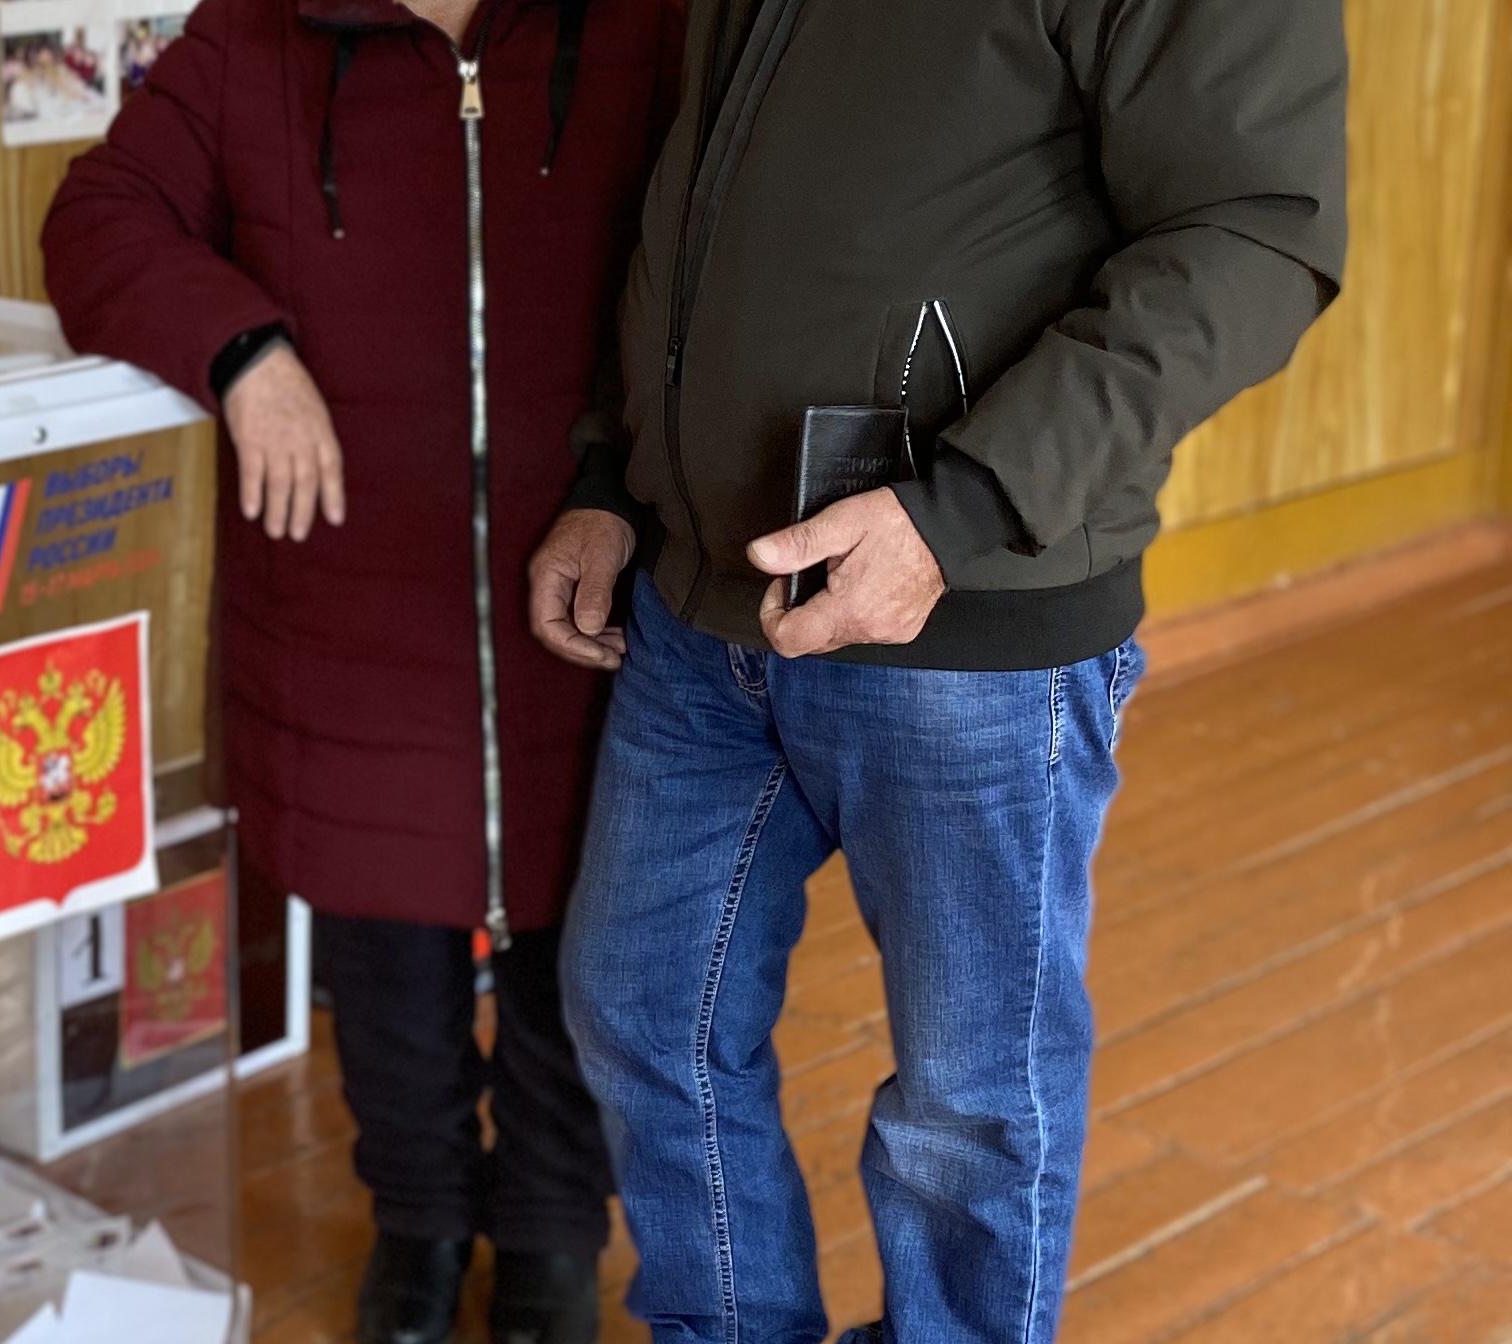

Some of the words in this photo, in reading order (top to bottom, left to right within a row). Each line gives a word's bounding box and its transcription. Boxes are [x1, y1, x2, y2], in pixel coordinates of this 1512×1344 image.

[44, 449, 144, 500] ВЫБОРЫ
[35, 476, 173, 537] ПРЕЗИДЕНТА
[27, 527, 116, 573] РОССИИ
